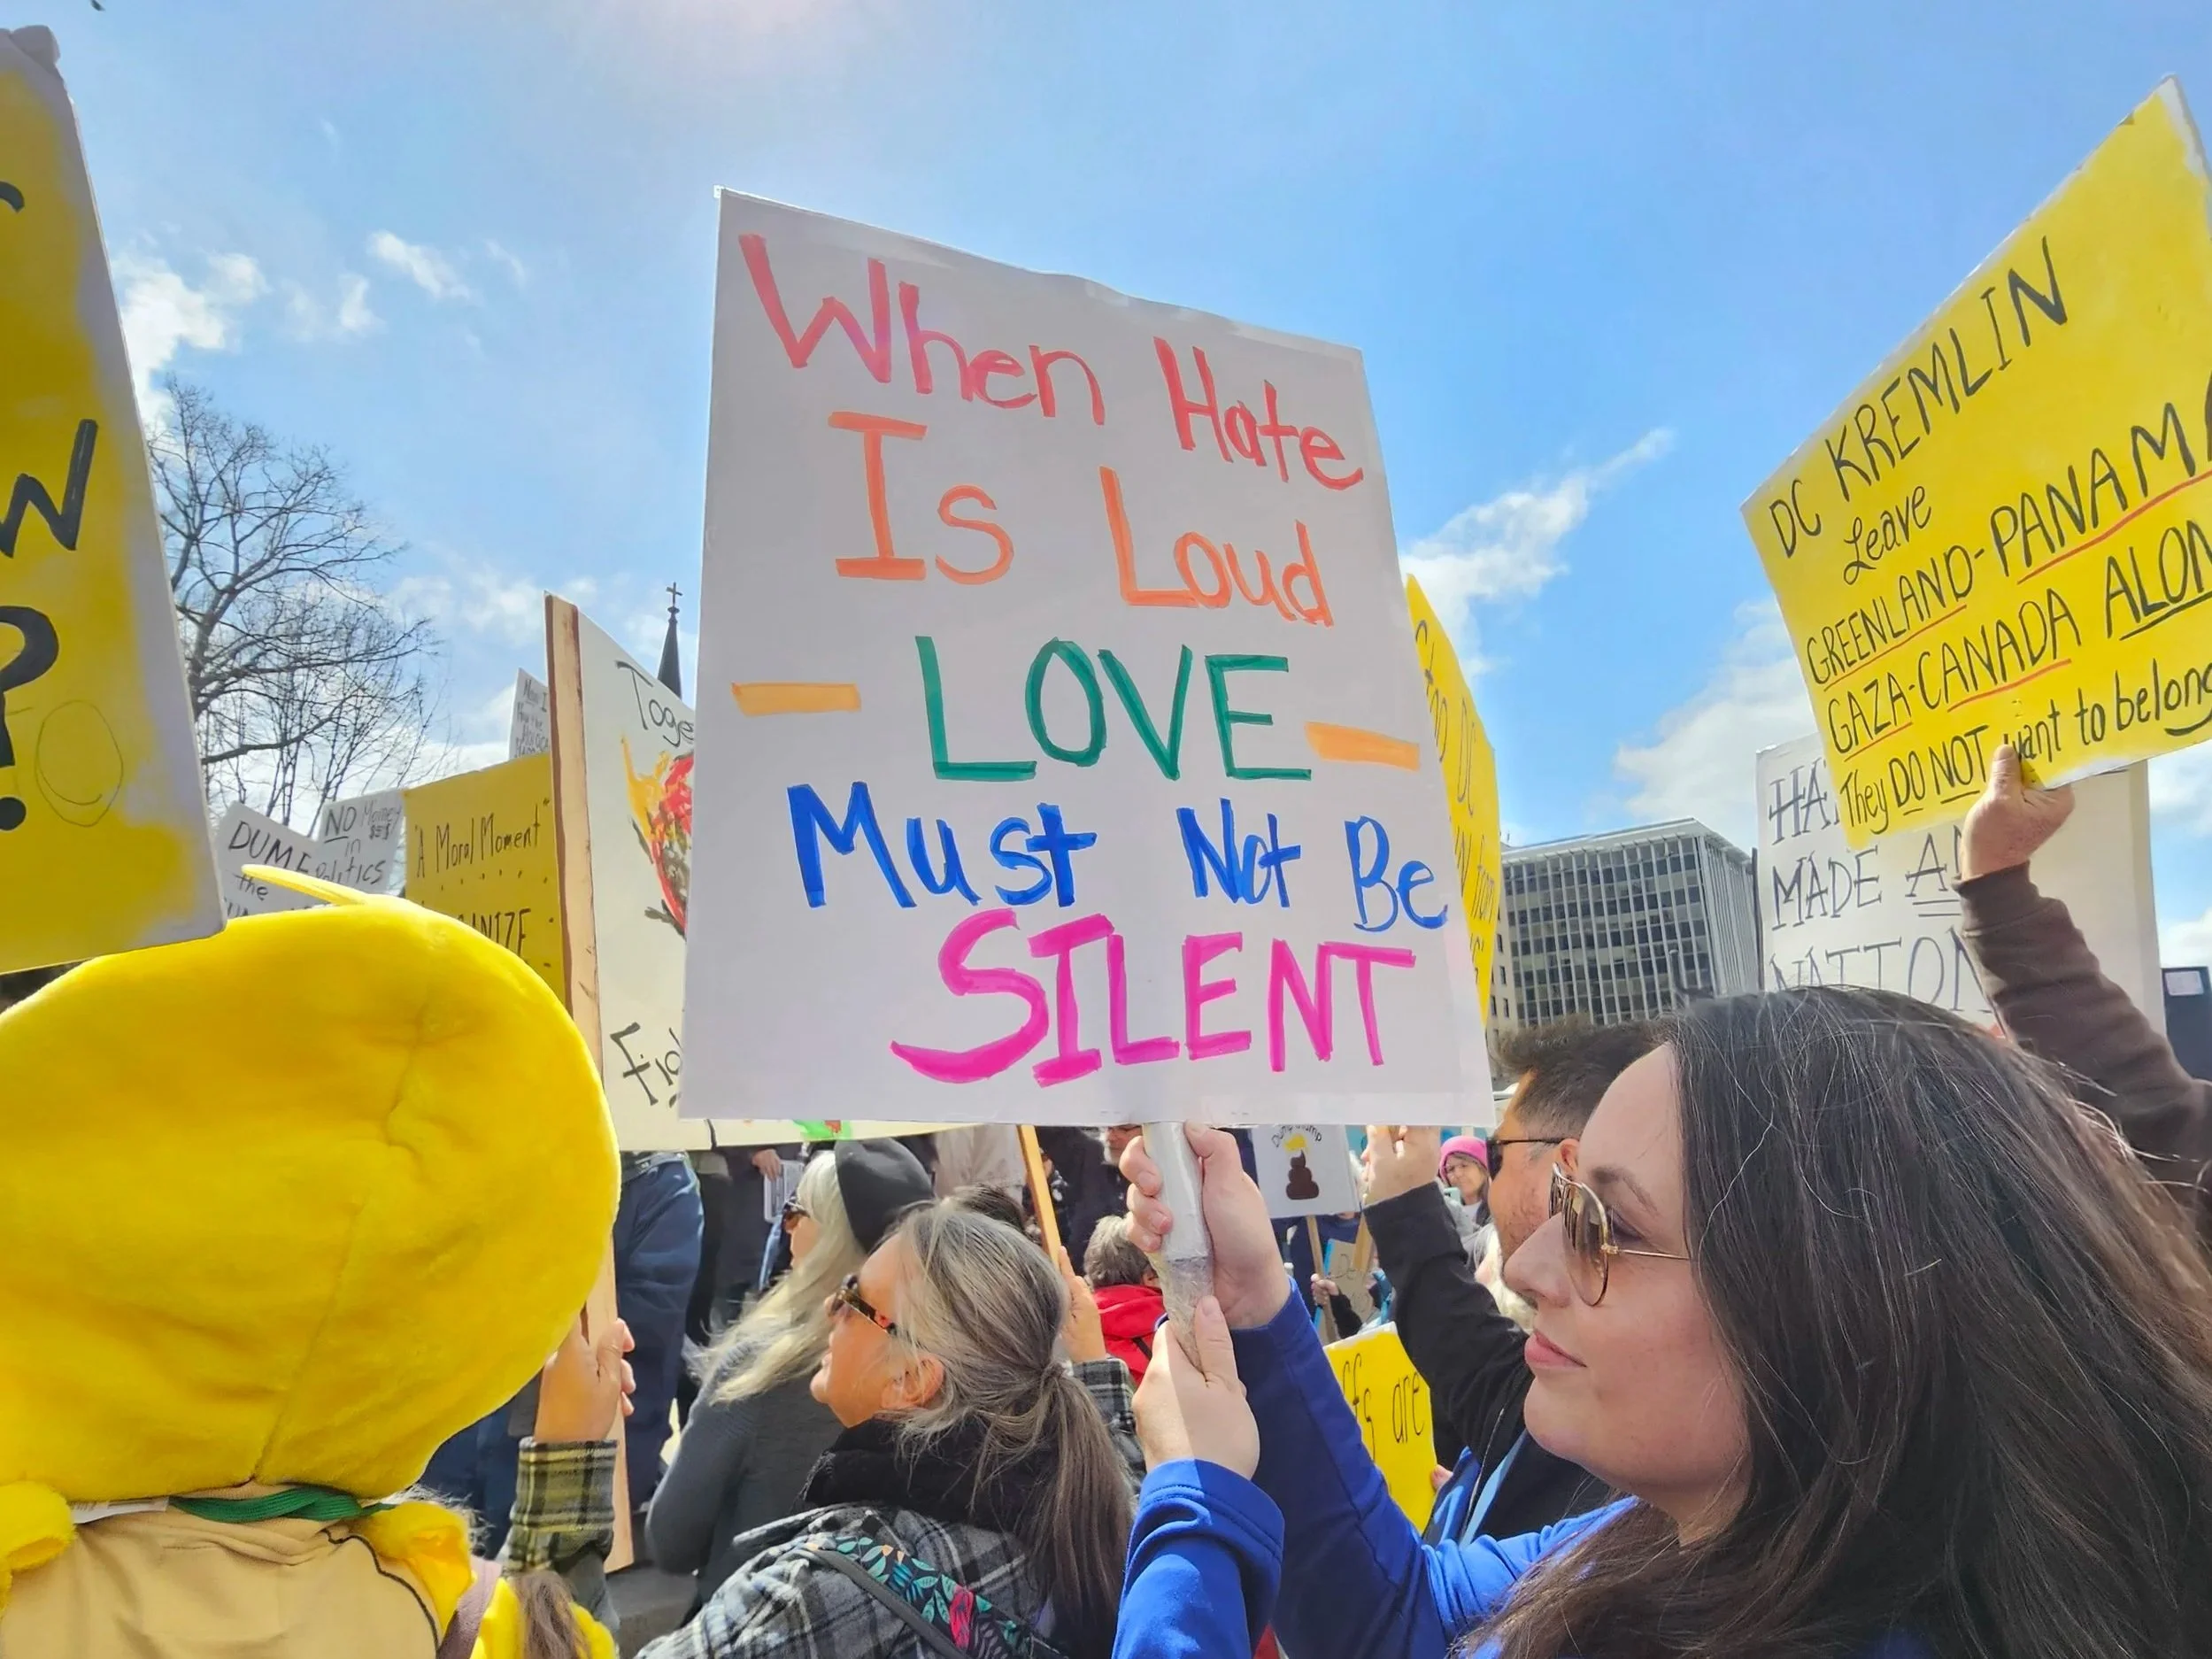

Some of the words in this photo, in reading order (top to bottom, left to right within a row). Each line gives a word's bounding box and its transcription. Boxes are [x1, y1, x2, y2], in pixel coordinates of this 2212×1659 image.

[737, 234, 1105, 426] When
[1153, 336, 1364, 490] Hate
[1769, 479, 1821, 559] DC
[1824, 235, 2069, 502] KREMLIN
[827, 411, 1014, 585] Is
[1098, 466, 1334, 628] Loud
[1843, 485, 1931, 585] Leave
[914, 635, 1312, 781] LOVE
[1840, 768, 1889, 835] They
[1889, 751, 1926, 807] DO
[1928, 724, 1989, 796] NOT
[2074, 687, 2106, 745] to
[325, 806, 357, 837] NO
[435, 817, 474, 873] Moral
[787, 781, 1098, 908] Must
[1175, 798, 1301, 908] Not
[1345, 815, 1449, 933] Be
[1771, 845, 1882, 930] MADE
[889, 907, 1416, 1088] SILENT
[1392, 1372, 1425, 1444] are
